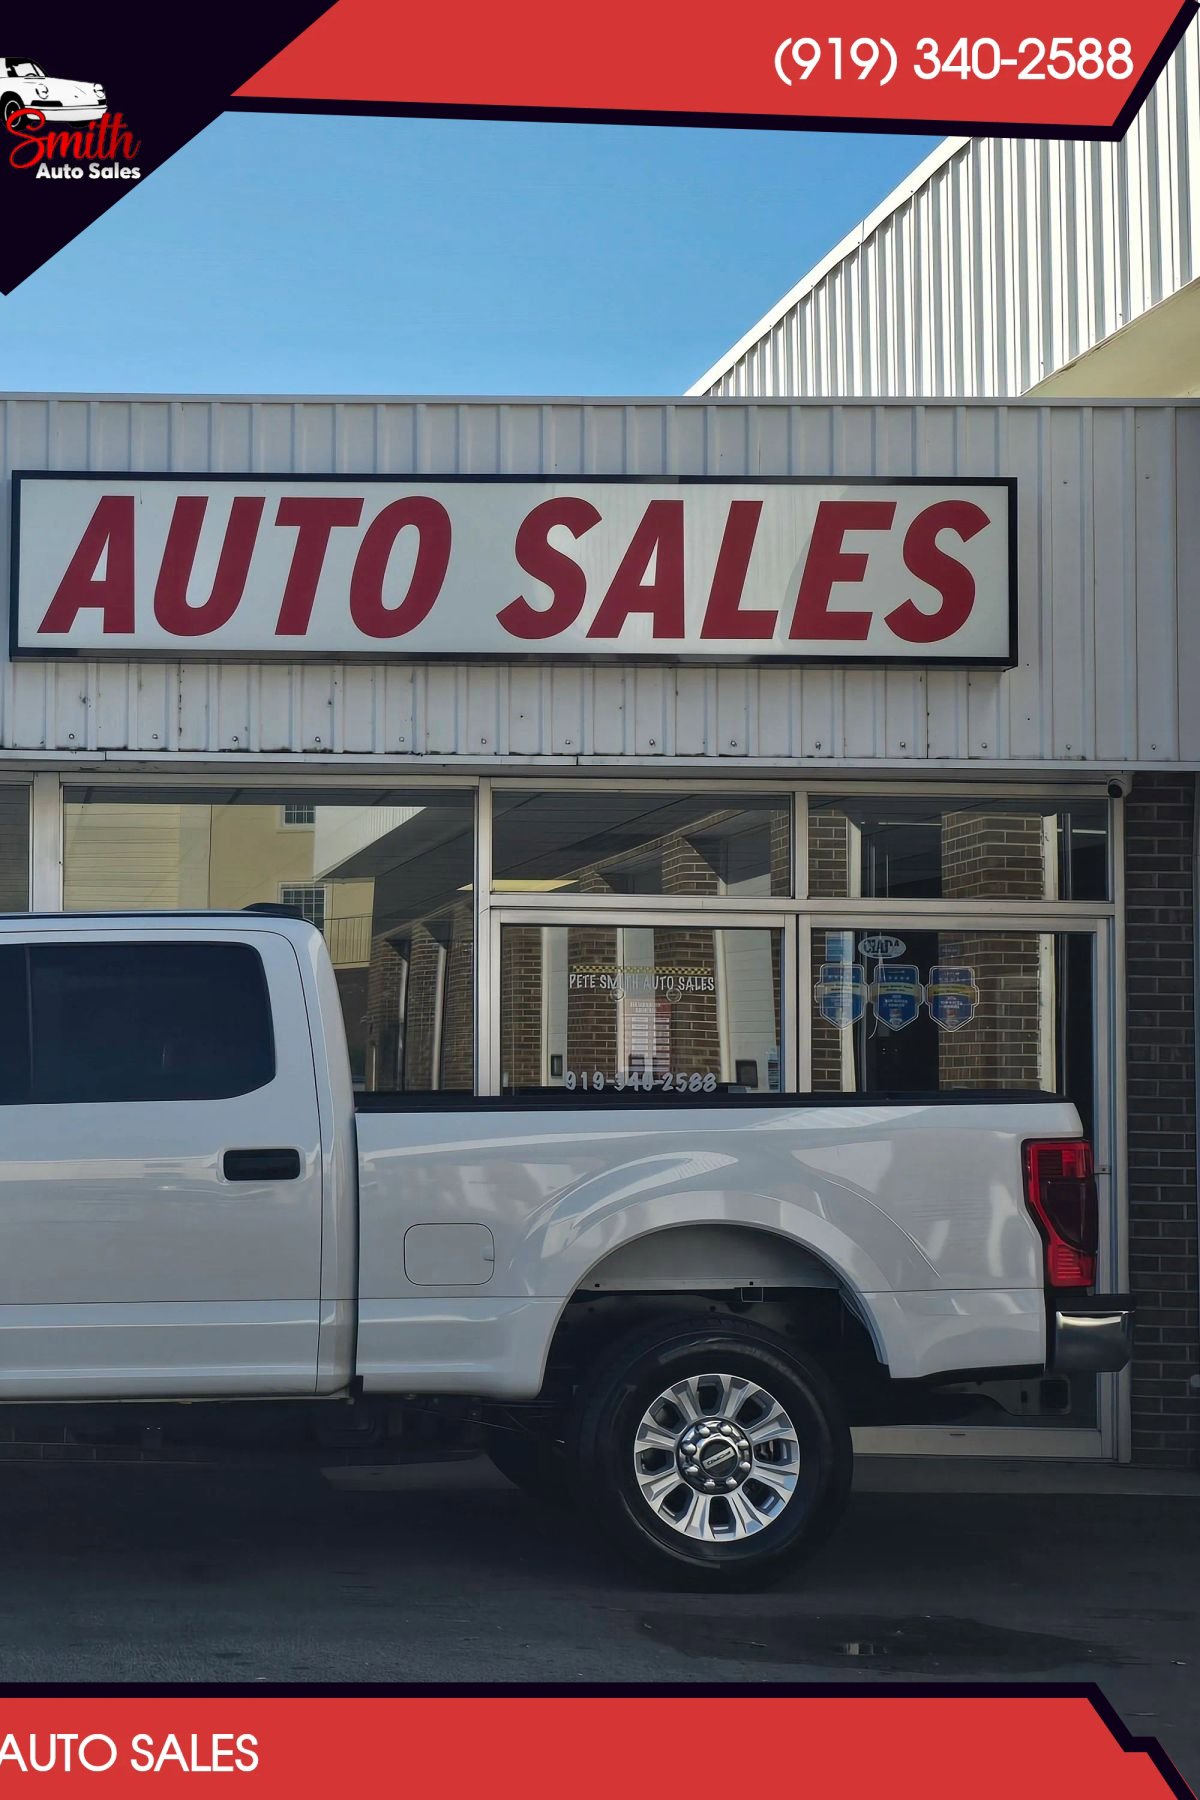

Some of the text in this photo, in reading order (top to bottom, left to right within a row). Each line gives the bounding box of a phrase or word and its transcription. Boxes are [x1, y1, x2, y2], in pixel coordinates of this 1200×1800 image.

[40, 496, 989, 642] AUTO SALES
[569, 974, 715, 991] PETE SMITH AUTO SALES
[565, 1071, 717, 1093] 919-340-2588
